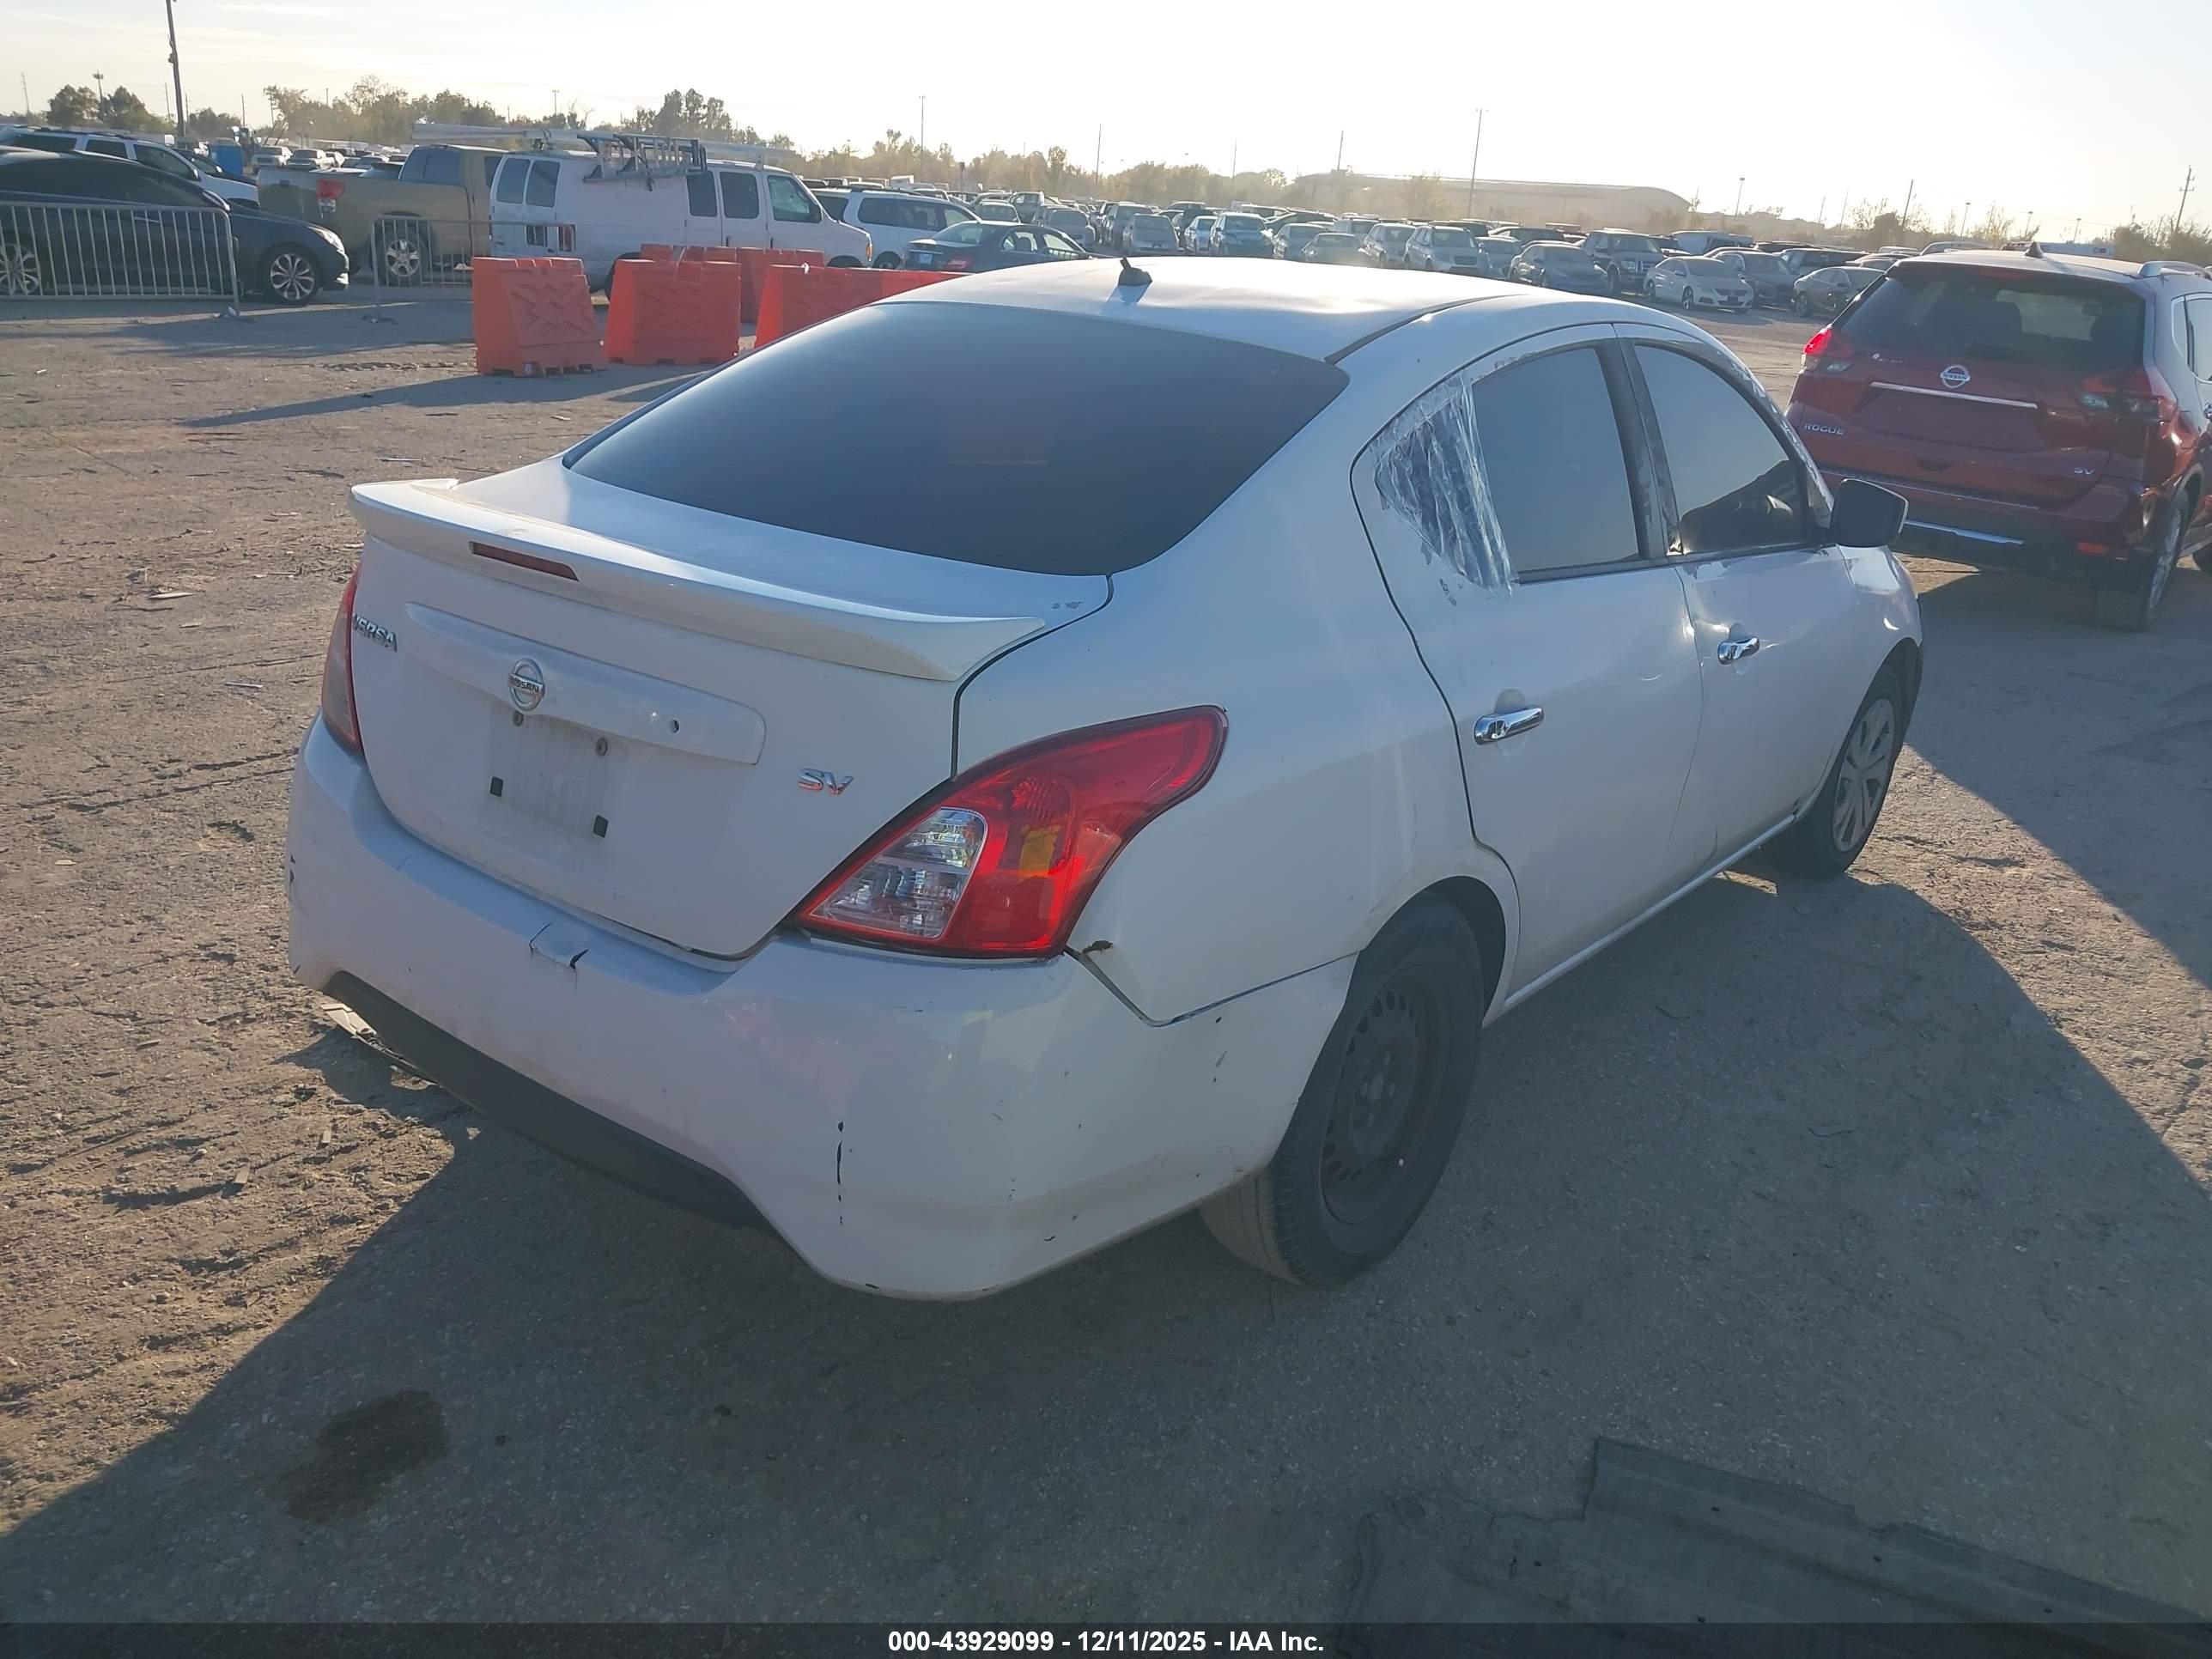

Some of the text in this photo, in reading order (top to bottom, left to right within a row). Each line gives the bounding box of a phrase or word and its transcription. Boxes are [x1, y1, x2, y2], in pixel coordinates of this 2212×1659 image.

[1804, 422, 1845, 435] ROGUE
[2074, 466, 2095, 475] SV
[353, 613, 398, 653] VERSA
[509, 674, 540, 693] NISSAN
[796, 768, 854, 795] SV
